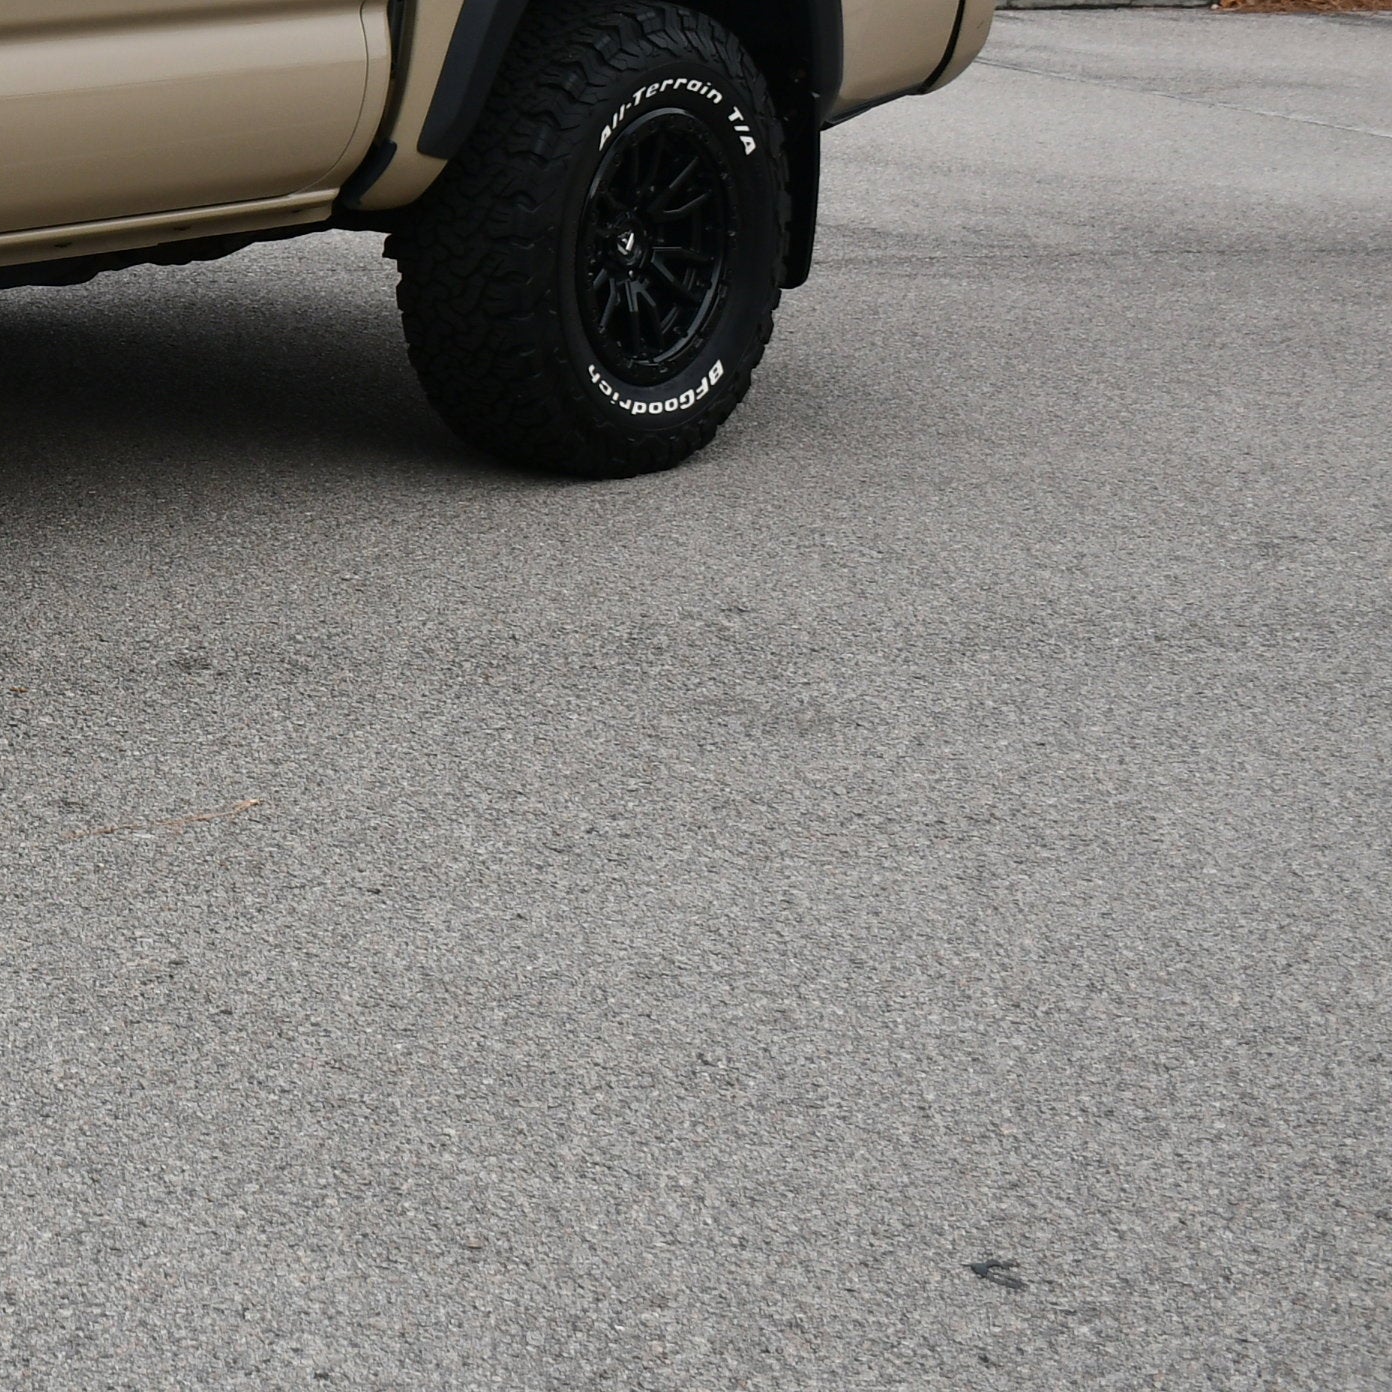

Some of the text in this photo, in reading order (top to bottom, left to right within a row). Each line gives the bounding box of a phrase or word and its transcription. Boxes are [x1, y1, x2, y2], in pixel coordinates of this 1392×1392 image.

[599, 78, 756, 155] All-Terrain T/A
[588, 359, 724, 415] BFGoodrich
